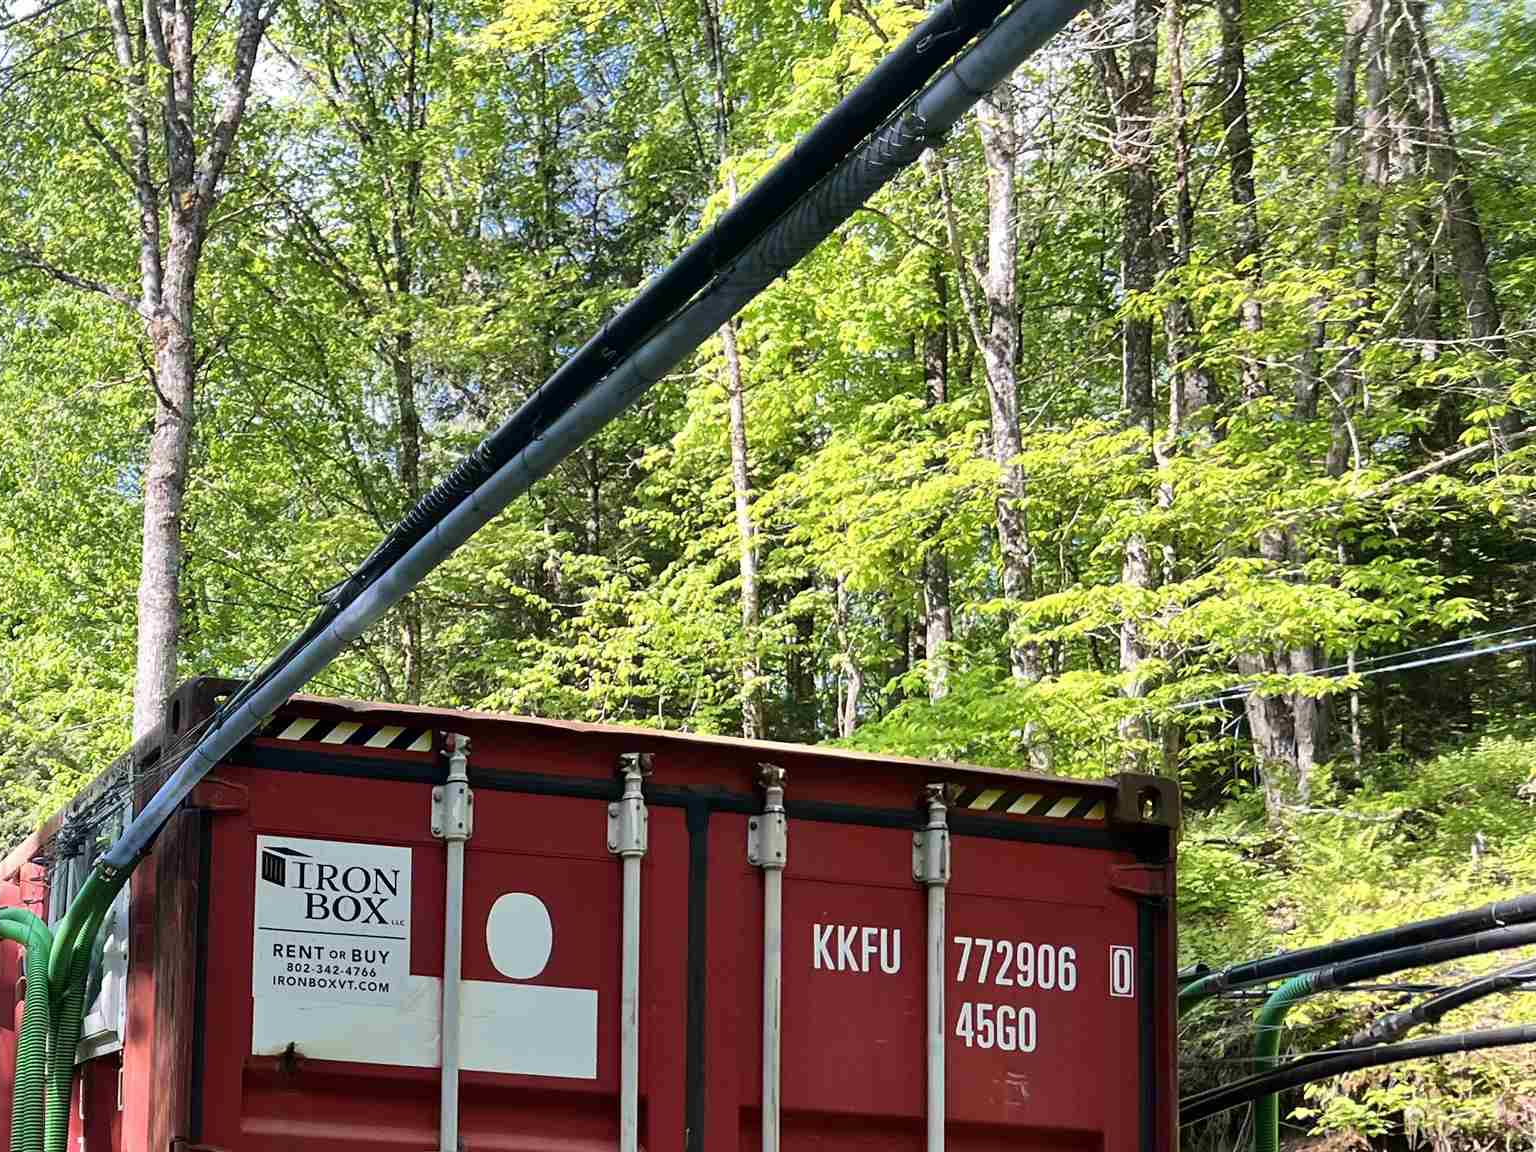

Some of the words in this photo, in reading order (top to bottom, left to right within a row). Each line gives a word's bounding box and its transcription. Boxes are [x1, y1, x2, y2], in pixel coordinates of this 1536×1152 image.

[291, 861, 400, 896] IRON
[305, 892, 389, 925] BOX
[273, 943, 325, 960] RENT
[329, 950, 346, 961] OR
[351, 949, 390, 965] BUY
[812, 923, 902, 974] KKFU
[954, 936, 1077, 992] 772906
[287, 962, 376, 978] 802-342-4766
[273, 975, 390, 993] IRONBOXVT.COM
